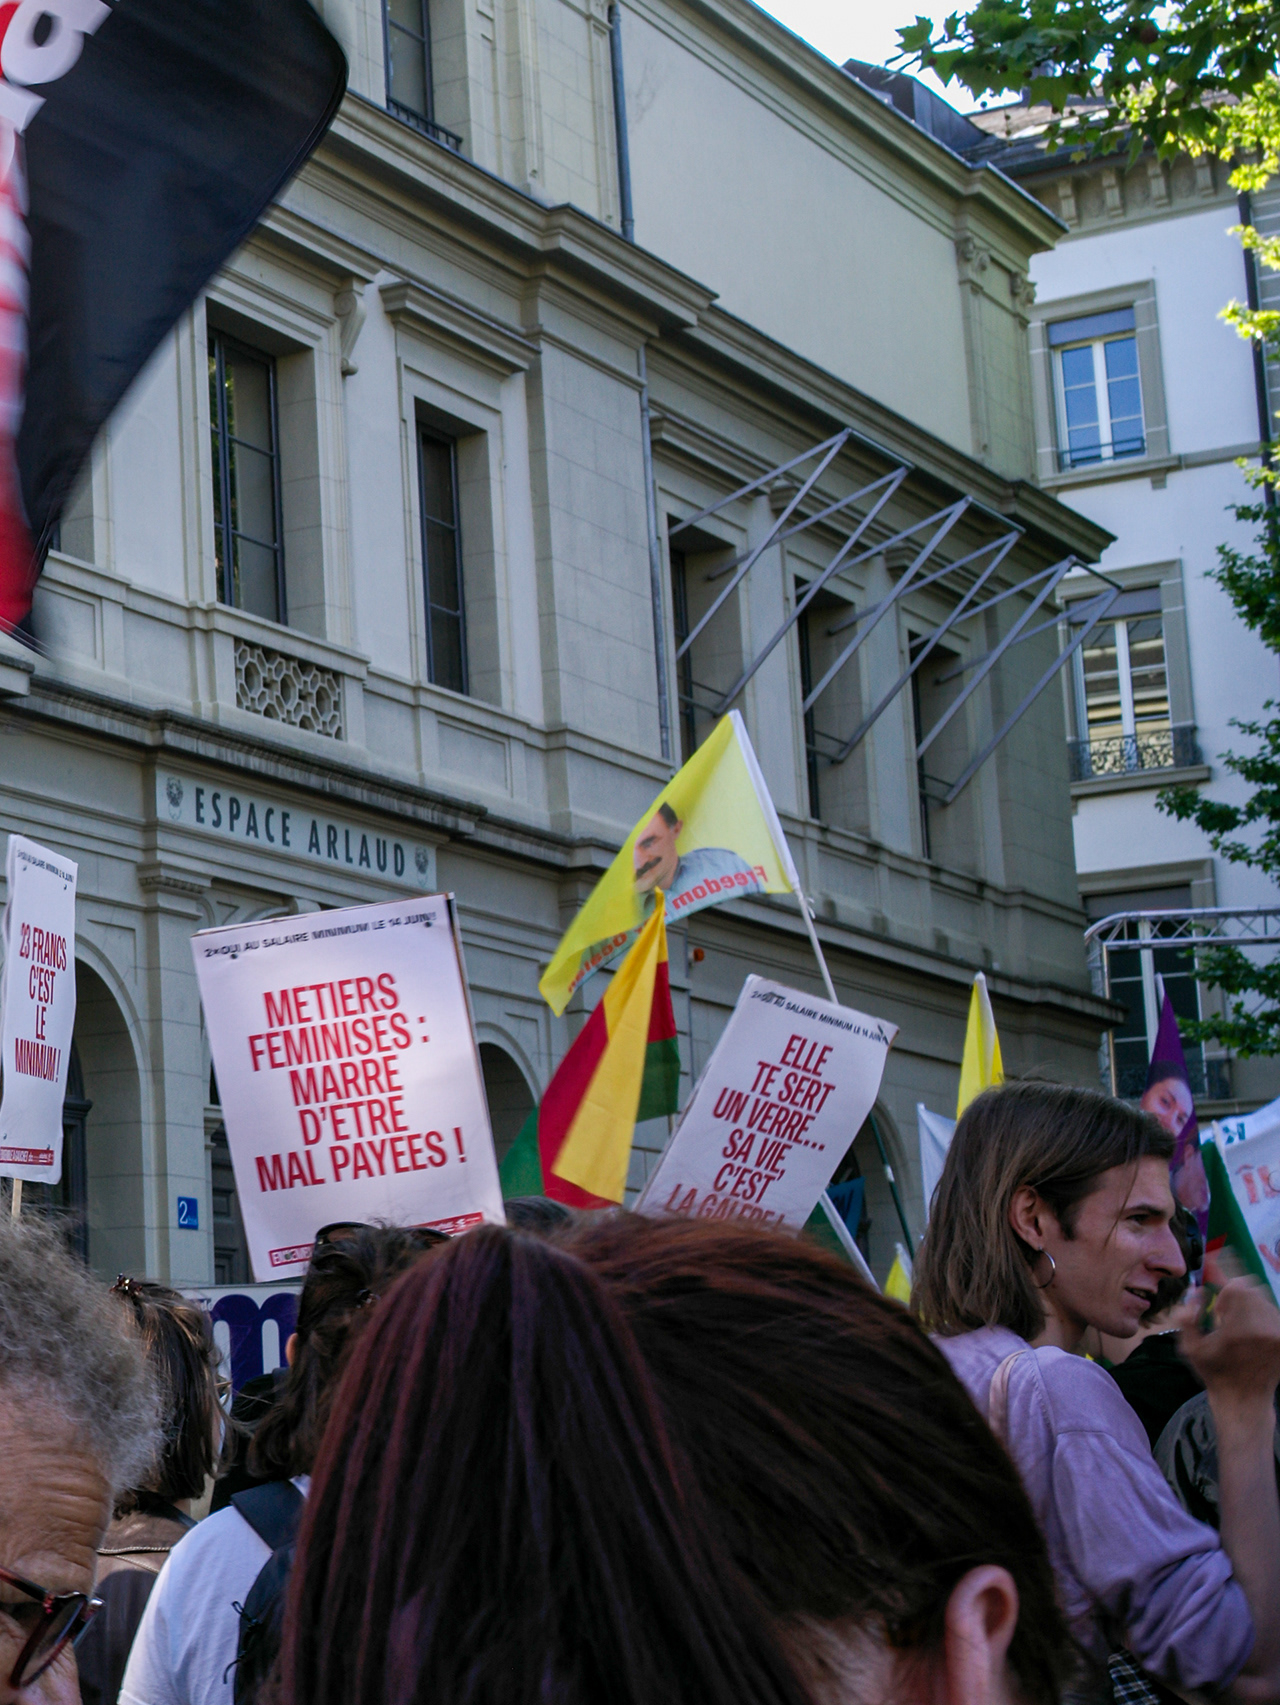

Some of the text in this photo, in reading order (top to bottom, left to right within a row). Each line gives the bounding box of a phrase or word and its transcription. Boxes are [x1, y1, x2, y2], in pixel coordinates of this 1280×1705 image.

[194, 786, 405, 878] ESPACE ARLAUD
[19, 922, 67, 972] 23 FRANCS
[243, 940, 260, 952] AU
[261, 932, 309, 949] SALAIRE
[310, 922, 370, 941] MINIMUM
[371, 919, 386, 931] LE
[28, 964, 56, 1005] C'EST
[262, 972, 400, 1029] METIERS
[35, 1004, 47, 1041] LE
[248, 1012, 413, 1072] FEMINISES
[785, 1001, 819, 1020] SALAIRE
[818, 1013, 853, 1032] MINIMUM
[853, 1024, 863, 1035] LE
[289, 1054, 404, 1107] MARRE
[780, 1034, 834, 1076] ELLE
[750, 1061, 836, 1113] TE SERT
[298, 1095, 410, 1146] D'ETRE
[712, 1087, 826, 1151] UN VERRE...
[254, 1126, 468, 1193] MAL PAYEES !
[722, 1128, 793, 1181] SA VIE,
[664, 1183, 698, 1214] LA
[712, 1162, 775, 1204] C'EST
